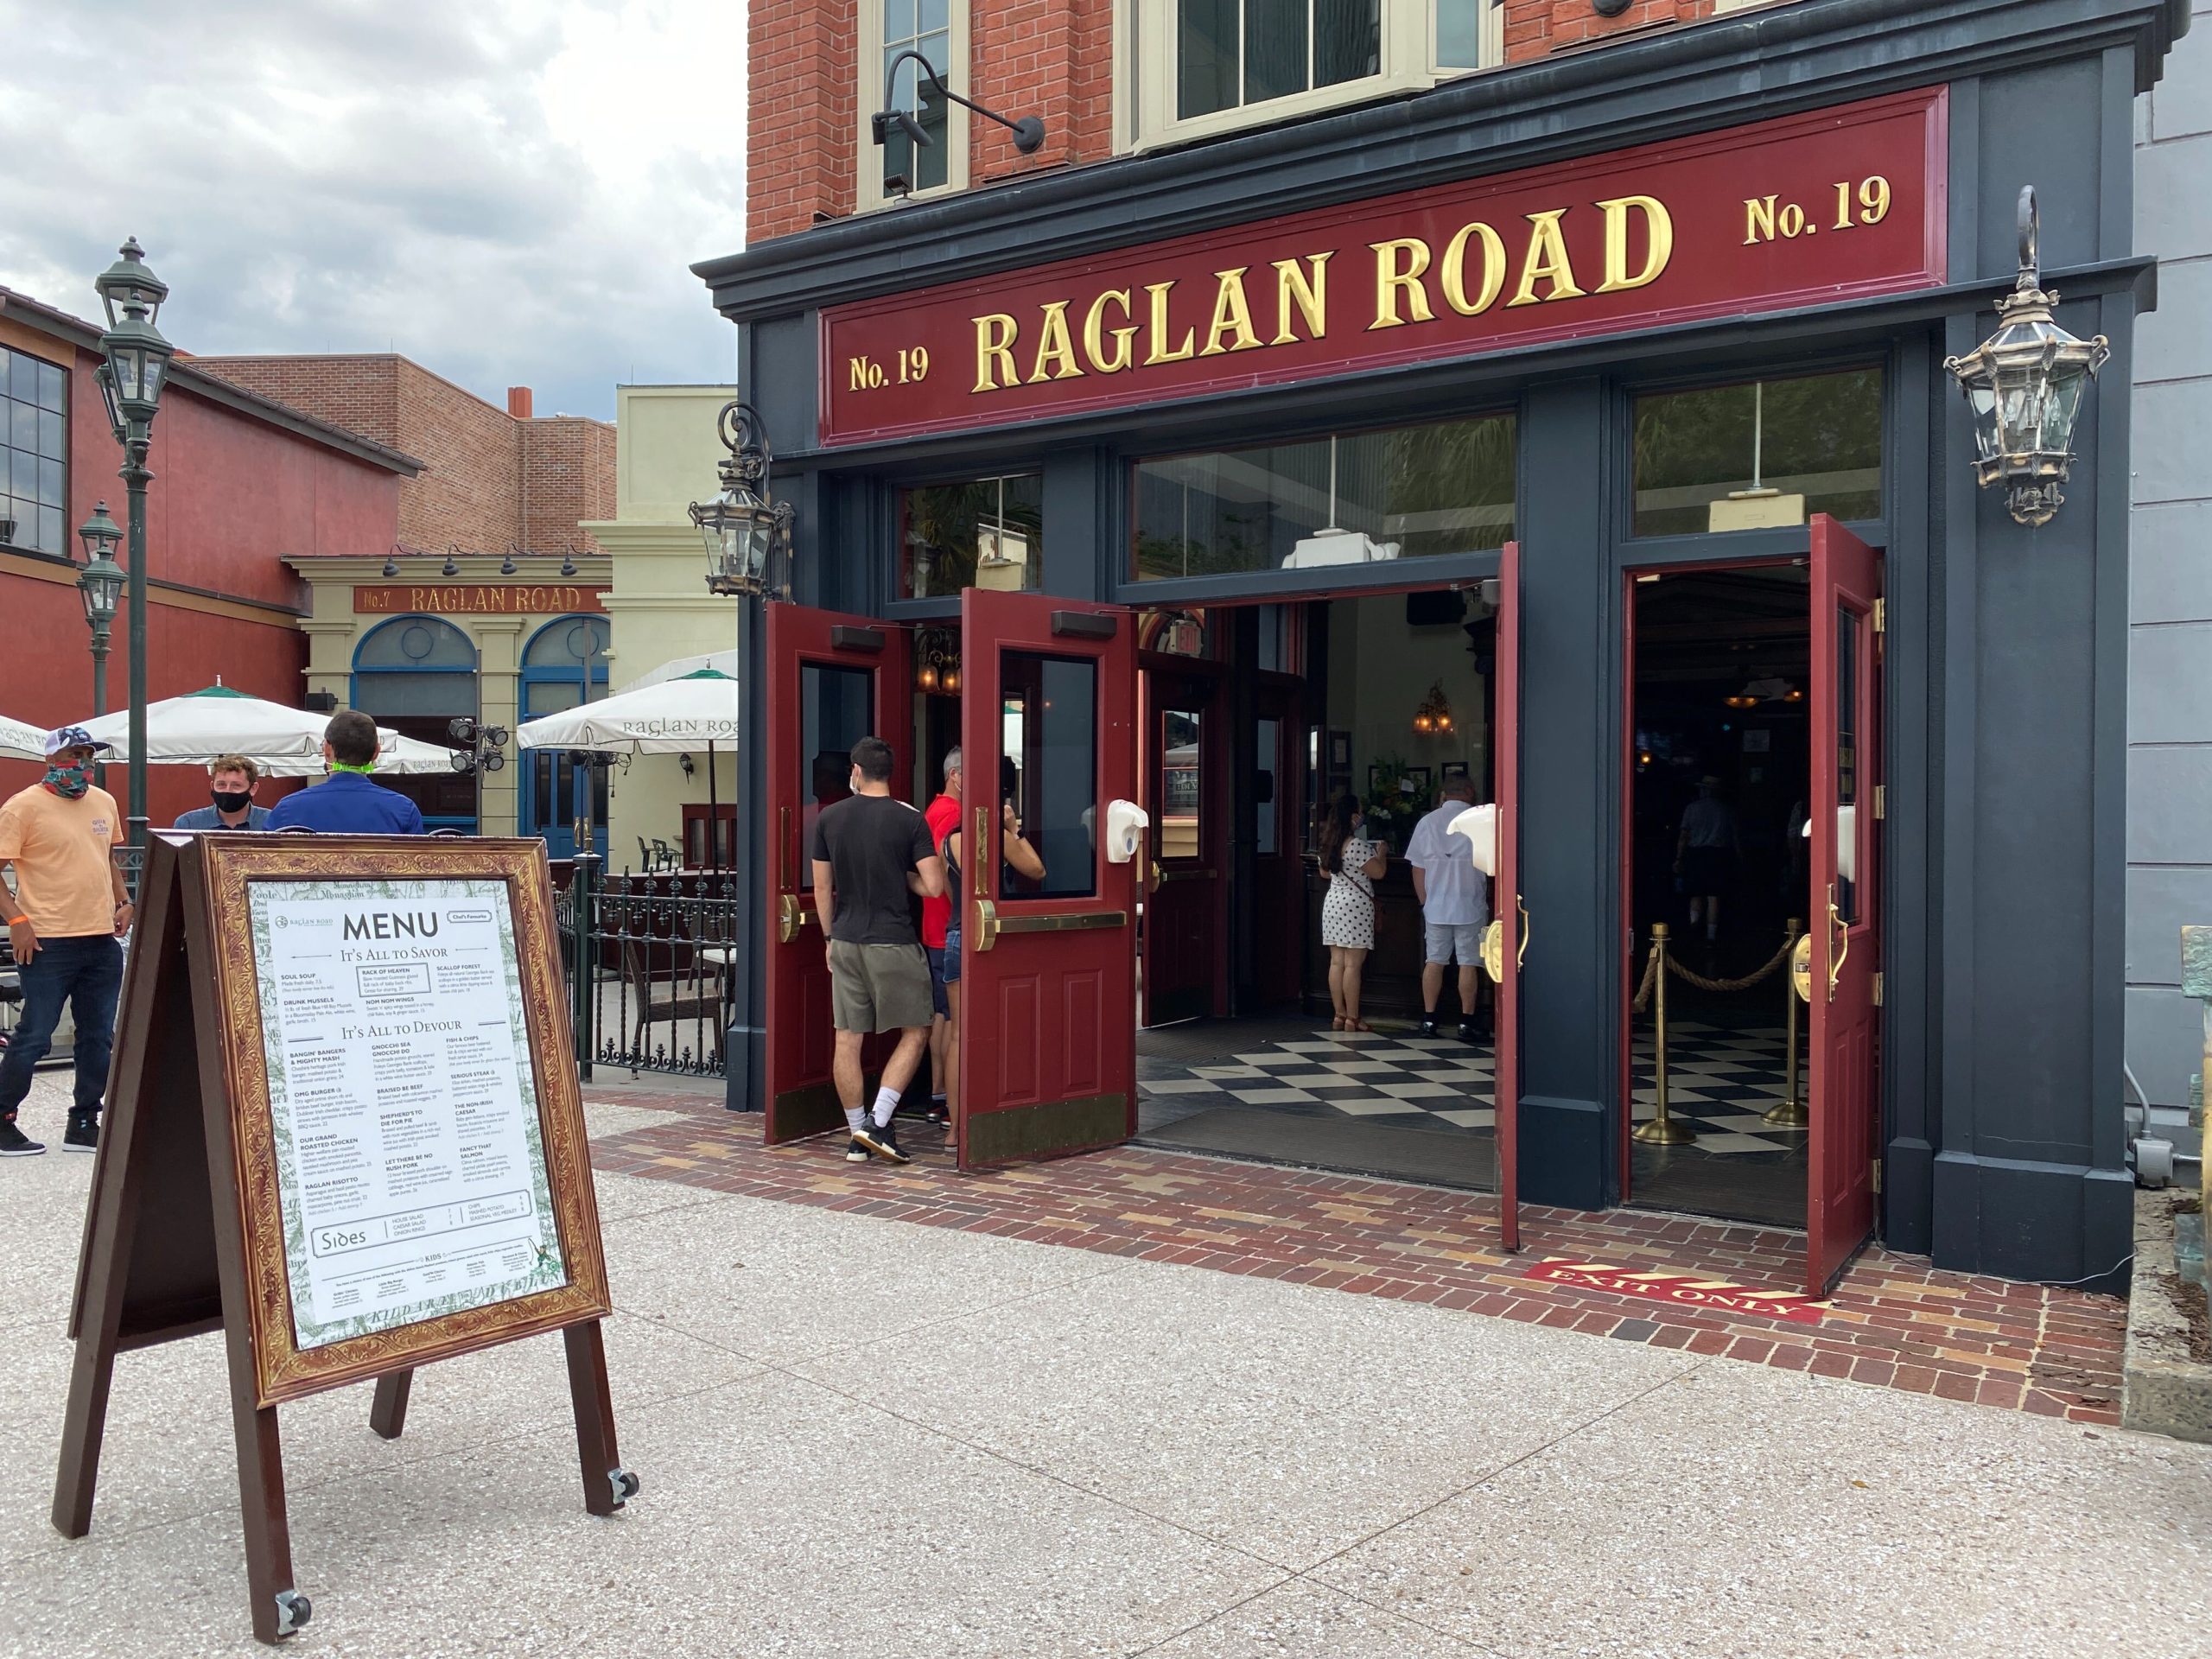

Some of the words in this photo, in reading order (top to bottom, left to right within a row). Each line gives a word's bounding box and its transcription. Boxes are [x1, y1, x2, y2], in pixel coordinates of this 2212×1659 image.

[1742, 194, 1817, 245] No.
[1832, 175, 1891, 230] 19
[969, 250, 1336, 394] RAGLAN
[1366, 194, 1674, 331] ROAD
[849, 355, 889, 391] No.
[897, 346, 929, 384] 19
[411, 587, 506, 612] RAGLAN
[515, 587, 582, 612] ROAD
[340, 912, 439, 940] MENU
[365, 948, 390, 960] ALL
[391, 949, 408, 959] TO
[410, 945, 448, 958] SAVOR
[366, 1023, 391, 1037] ALL
[394, 1024, 410, 1034] TO
[412, 1017, 462, 1033] DEVOUR
[300, 1141, 329, 1150] ROASTED
[305, 1180, 330, 1189] RAGLAN
[321, 1226, 366, 1249] Sides
[425, 1253, 442, 1262] KIDS
[1545, 1269, 1660, 1294] EXIT
[1671, 1290, 1802, 1316] ONLY
